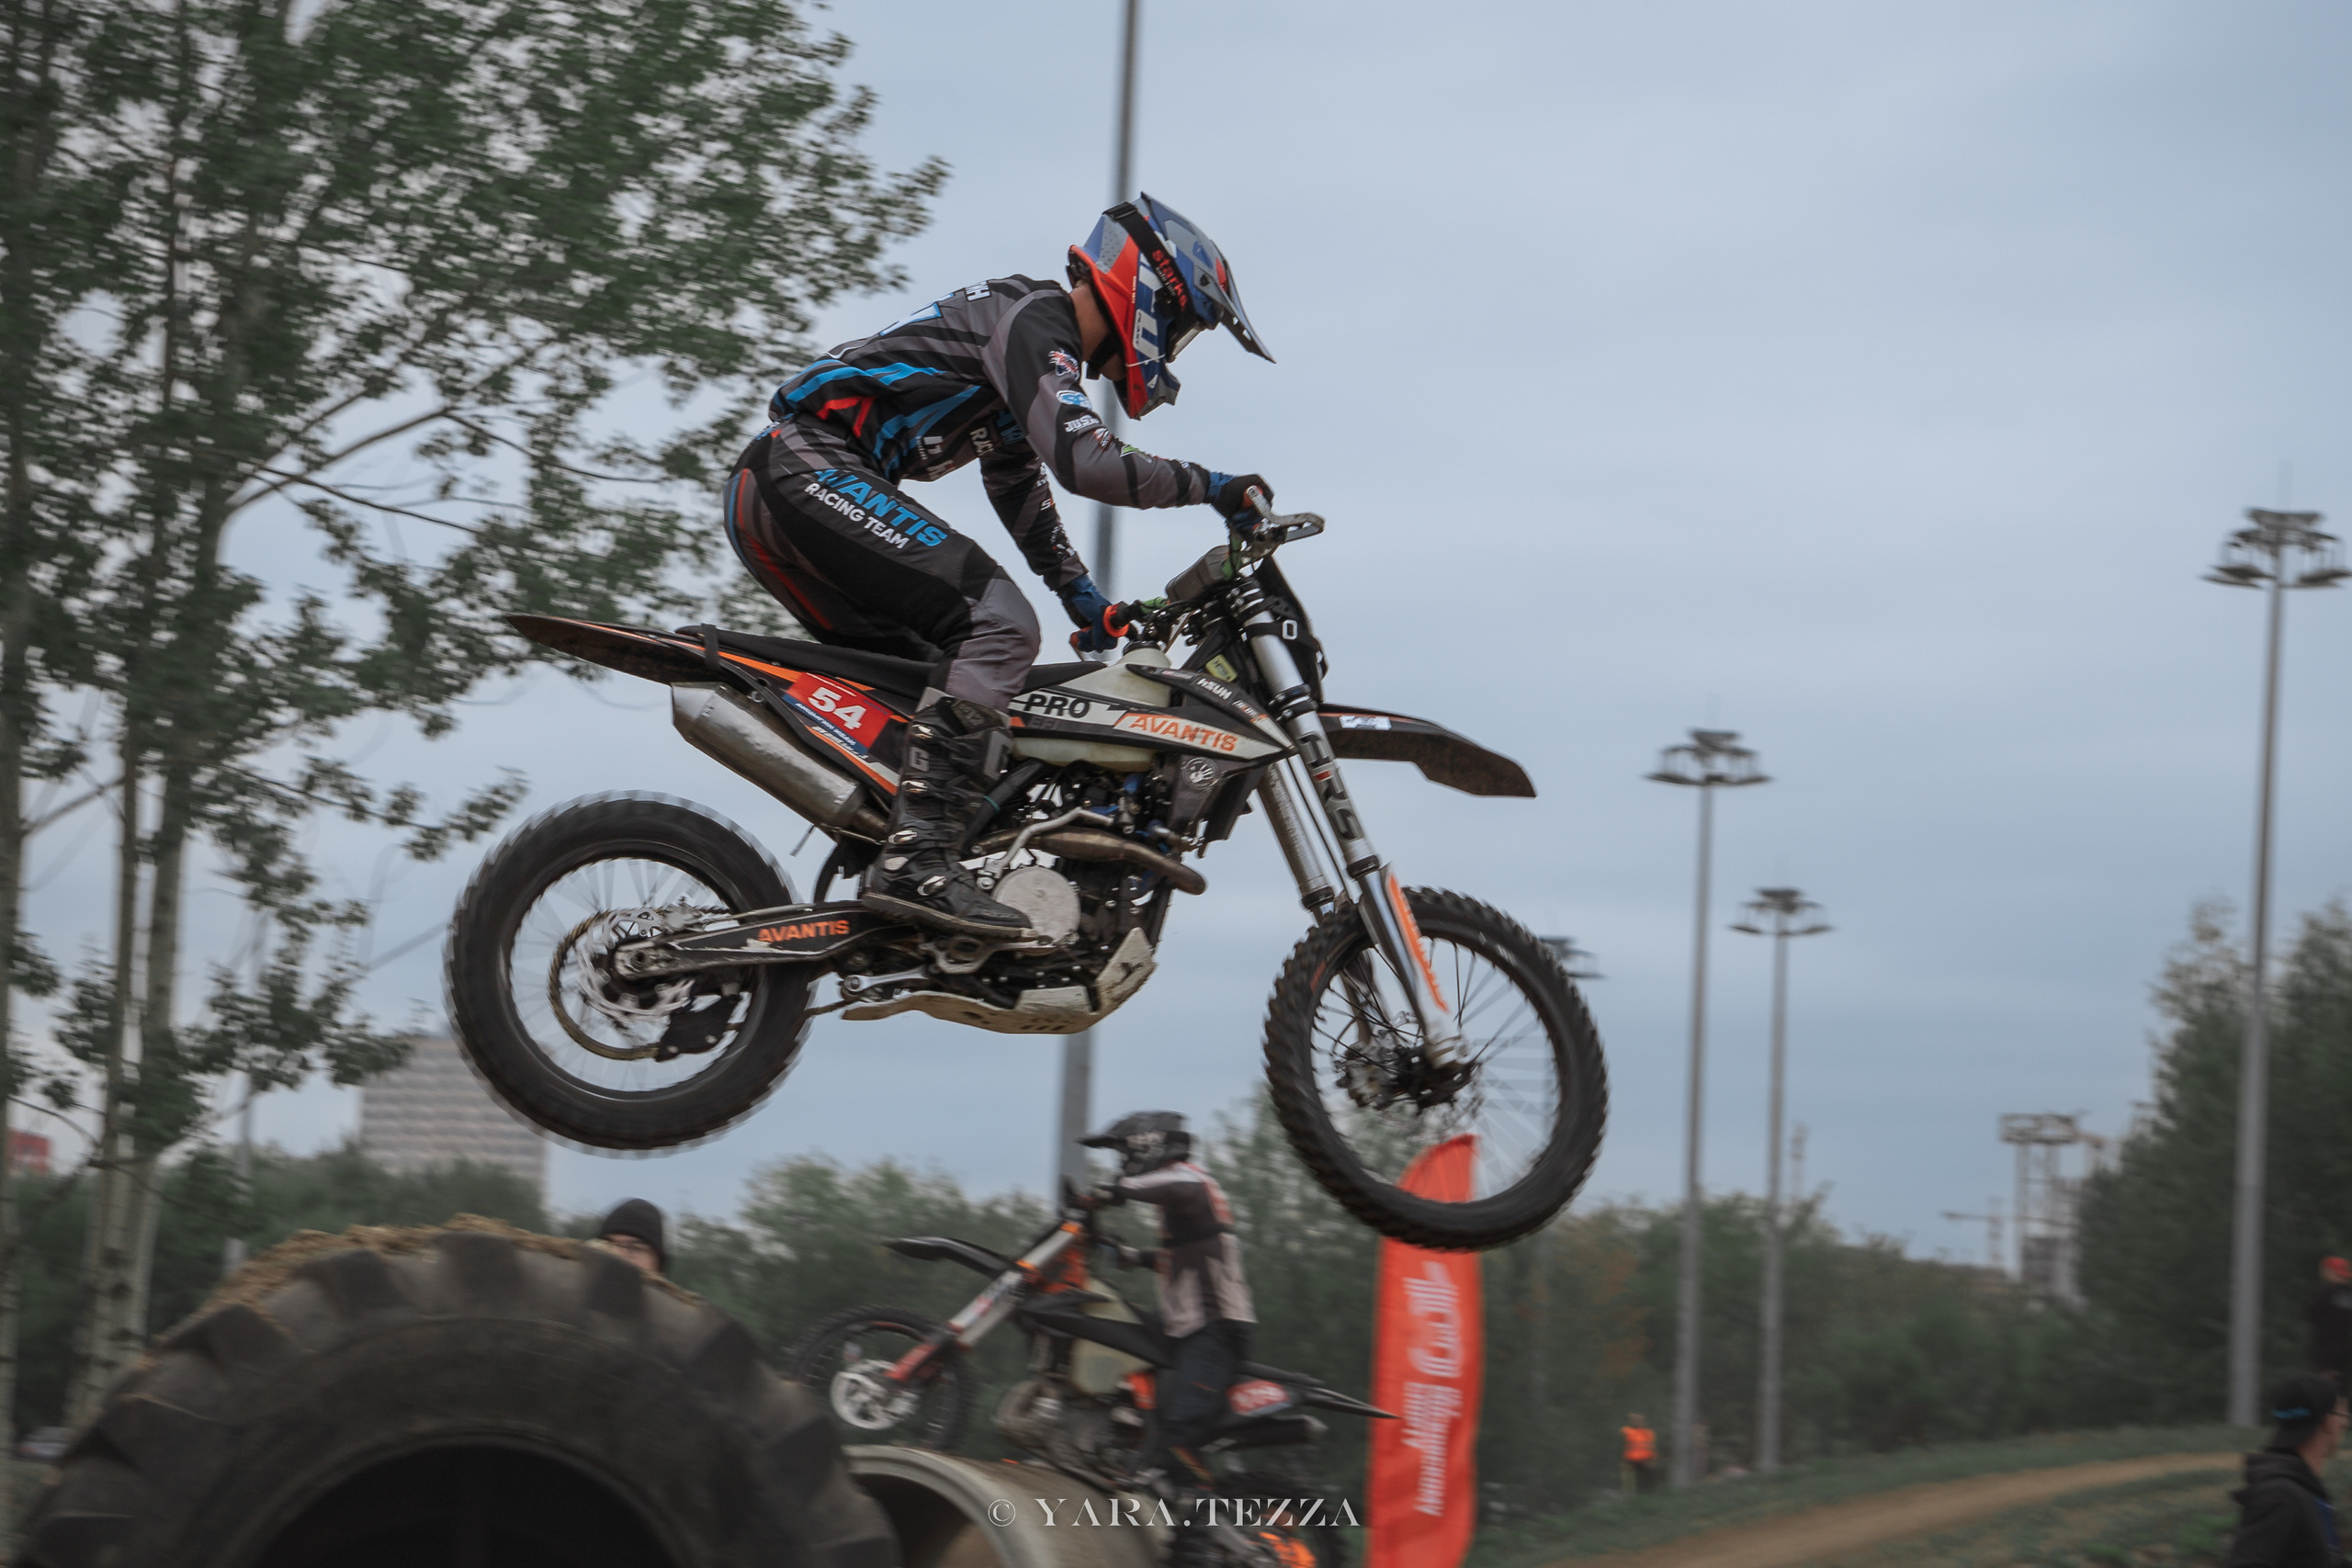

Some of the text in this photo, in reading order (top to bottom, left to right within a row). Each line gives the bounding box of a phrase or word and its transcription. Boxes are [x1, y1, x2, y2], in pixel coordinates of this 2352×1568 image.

[804, 482, 910, 549] RACING TEAM
[808, 686, 867, 731] 54
[1023, 694, 1091, 718] PRO
[1128, 714, 1238, 752] AVANTIS
[757, 919, 850, 942] AVANTIS
